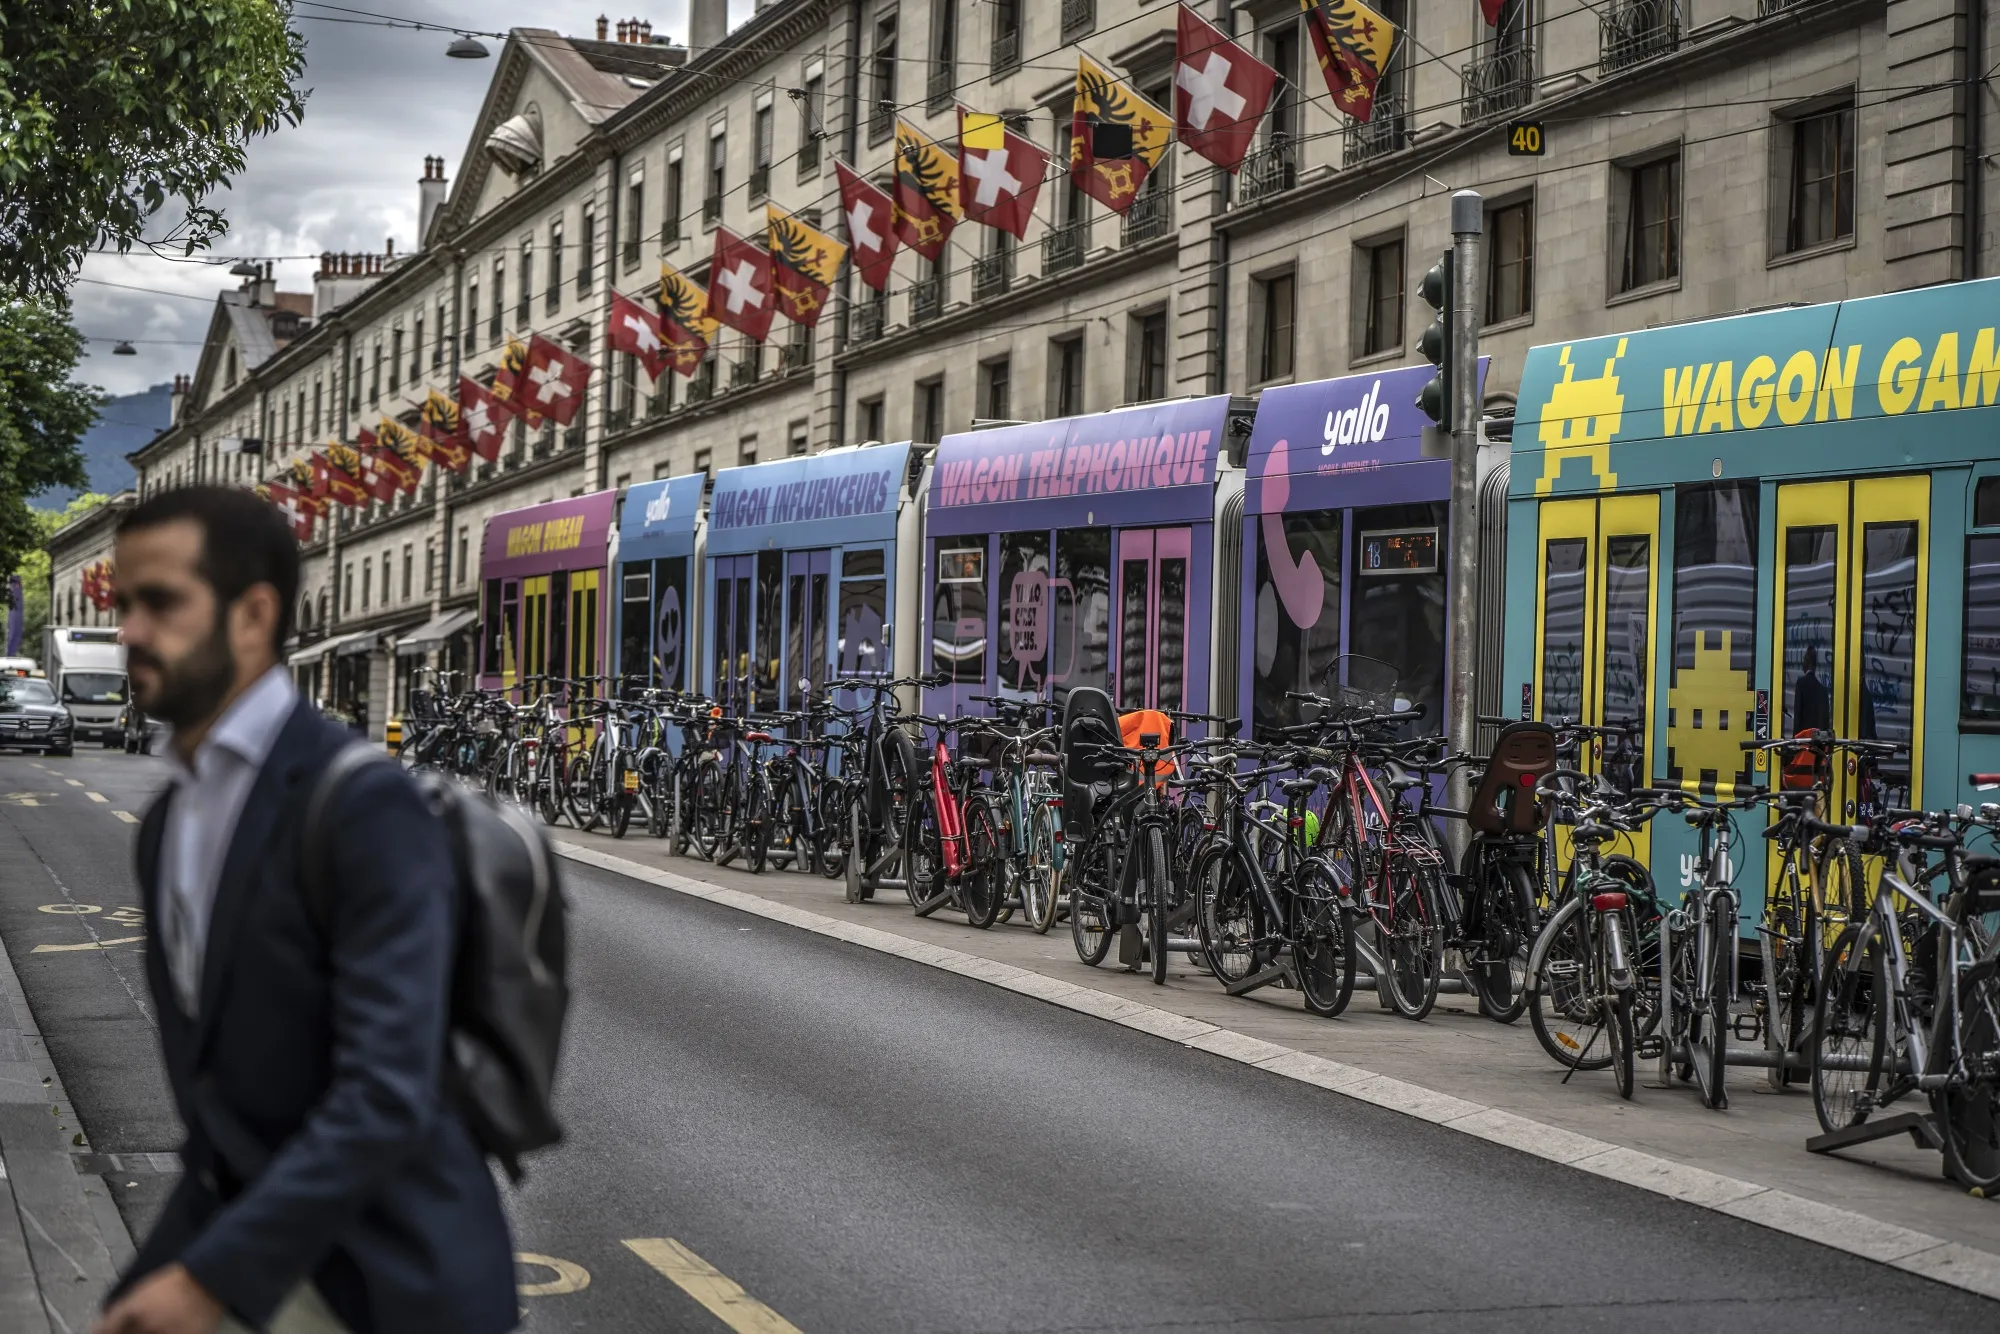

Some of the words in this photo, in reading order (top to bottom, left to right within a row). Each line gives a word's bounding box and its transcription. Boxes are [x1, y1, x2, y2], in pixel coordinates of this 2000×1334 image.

[1512, 126, 1540, 152] 40
[1321, 379, 1390, 456] yallo
[1663, 344, 1862, 437] WAGON
[940, 453, 1024, 507] WAGON
[1026, 429, 1212, 499] TÉLÉPHONIQUE
[715, 486, 772, 530] WAGON
[772, 469, 891, 523] INFLUENCEURS
[506, 522, 544, 559] WAGON
[1367, 541, 1381, 568] 18
